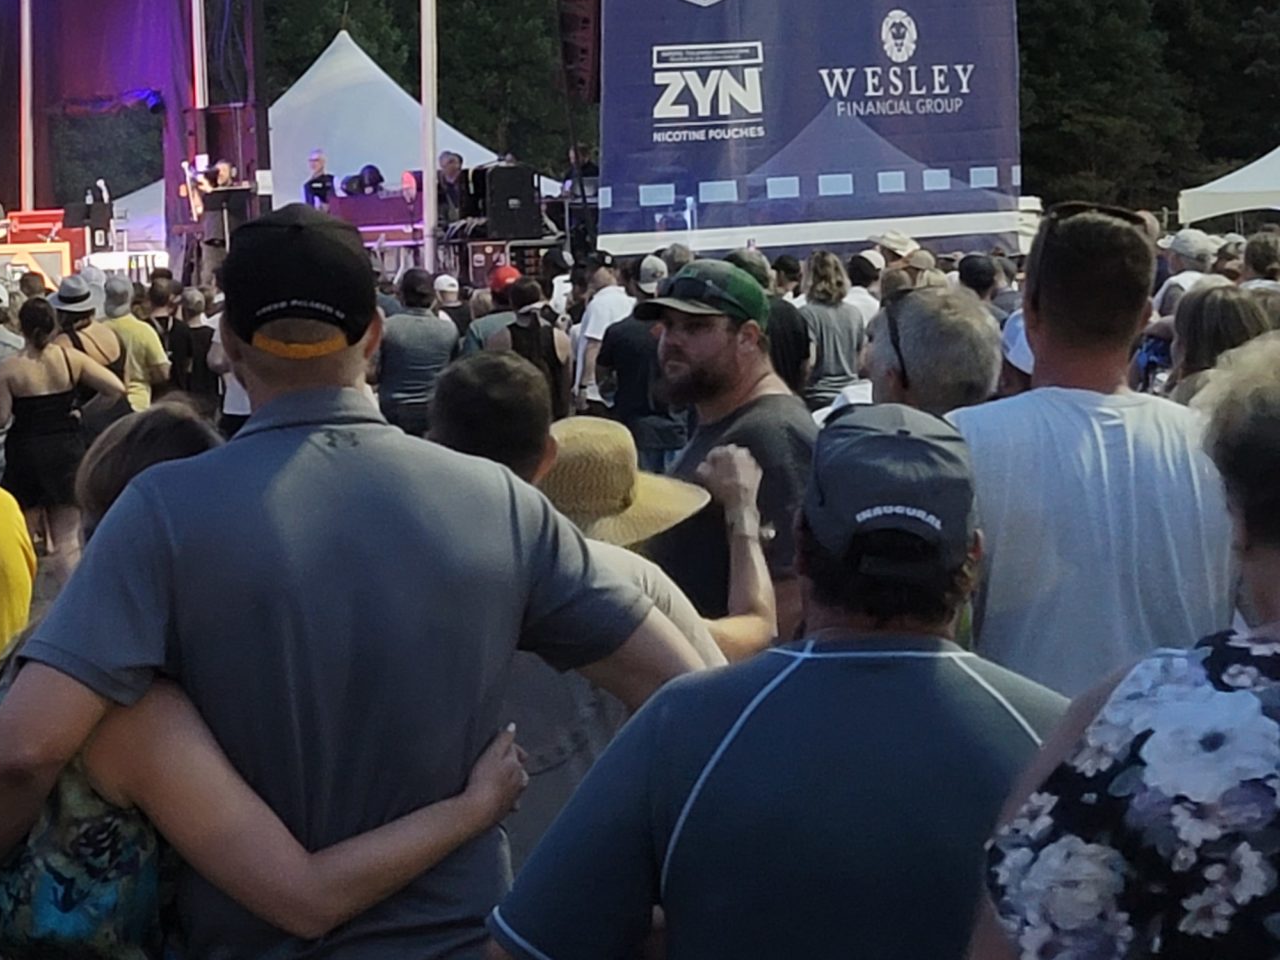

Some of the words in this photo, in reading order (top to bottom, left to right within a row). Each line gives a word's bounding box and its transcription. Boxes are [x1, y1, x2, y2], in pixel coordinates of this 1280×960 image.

[653, 68, 762, 119] ZYN
[818, 64, 976, 98] WESLEY
[836, 99, 914, 118] FINANCIAL
[915, 97, 964, 116] GROUP
[652, 129, 707, 143] NICOTINE
[708, 126, 765, 140] POUCHES
[855, 505, 942, 531] INAUGURAL
